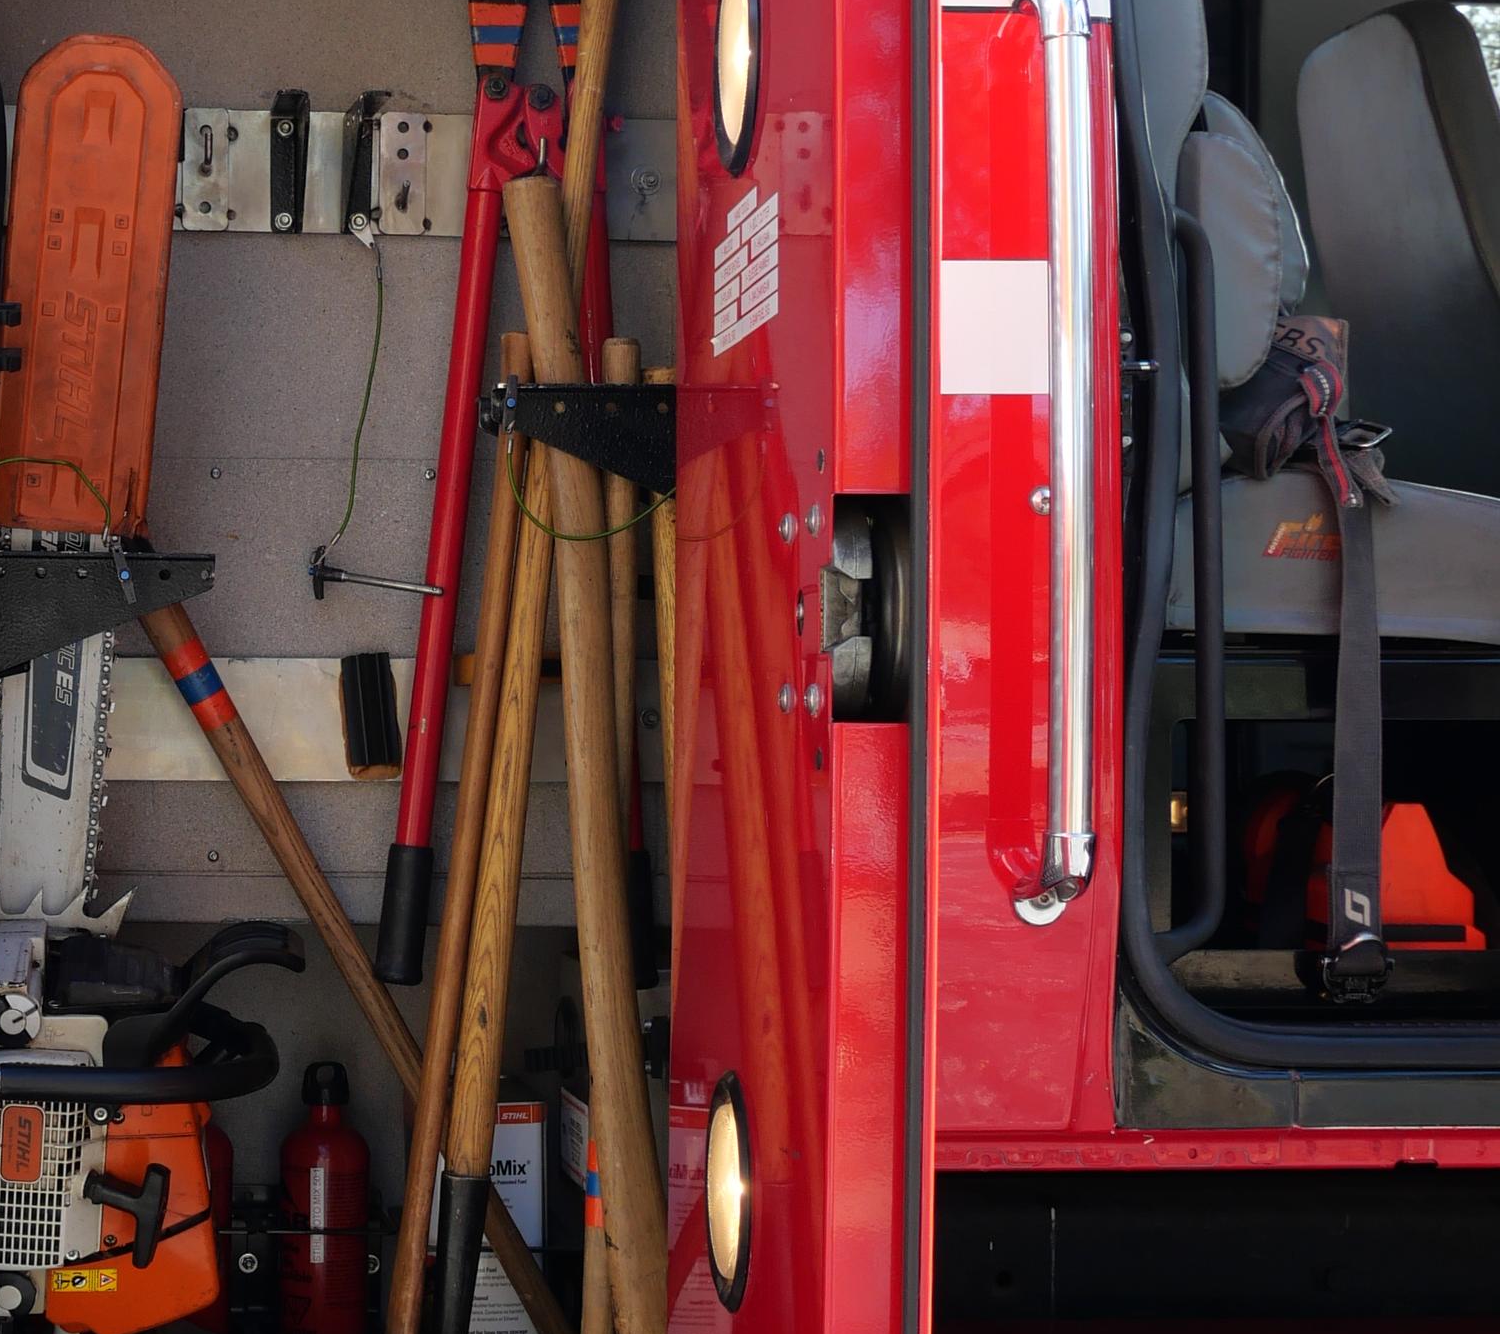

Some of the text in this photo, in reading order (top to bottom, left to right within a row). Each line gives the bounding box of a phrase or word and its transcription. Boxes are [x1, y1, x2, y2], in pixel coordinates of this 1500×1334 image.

[54, 290, 98, 439] STIHL
[55, 670, 74, 707] ES
[17, 1116, 32, 1172] STIHL
[488, 1160, 526, 1176] oMix
[313, 1189, 322, 1204] MIX
[313, 1207, 322, 1231] OTO
[313, 1236, 322, 1262] STIHL
